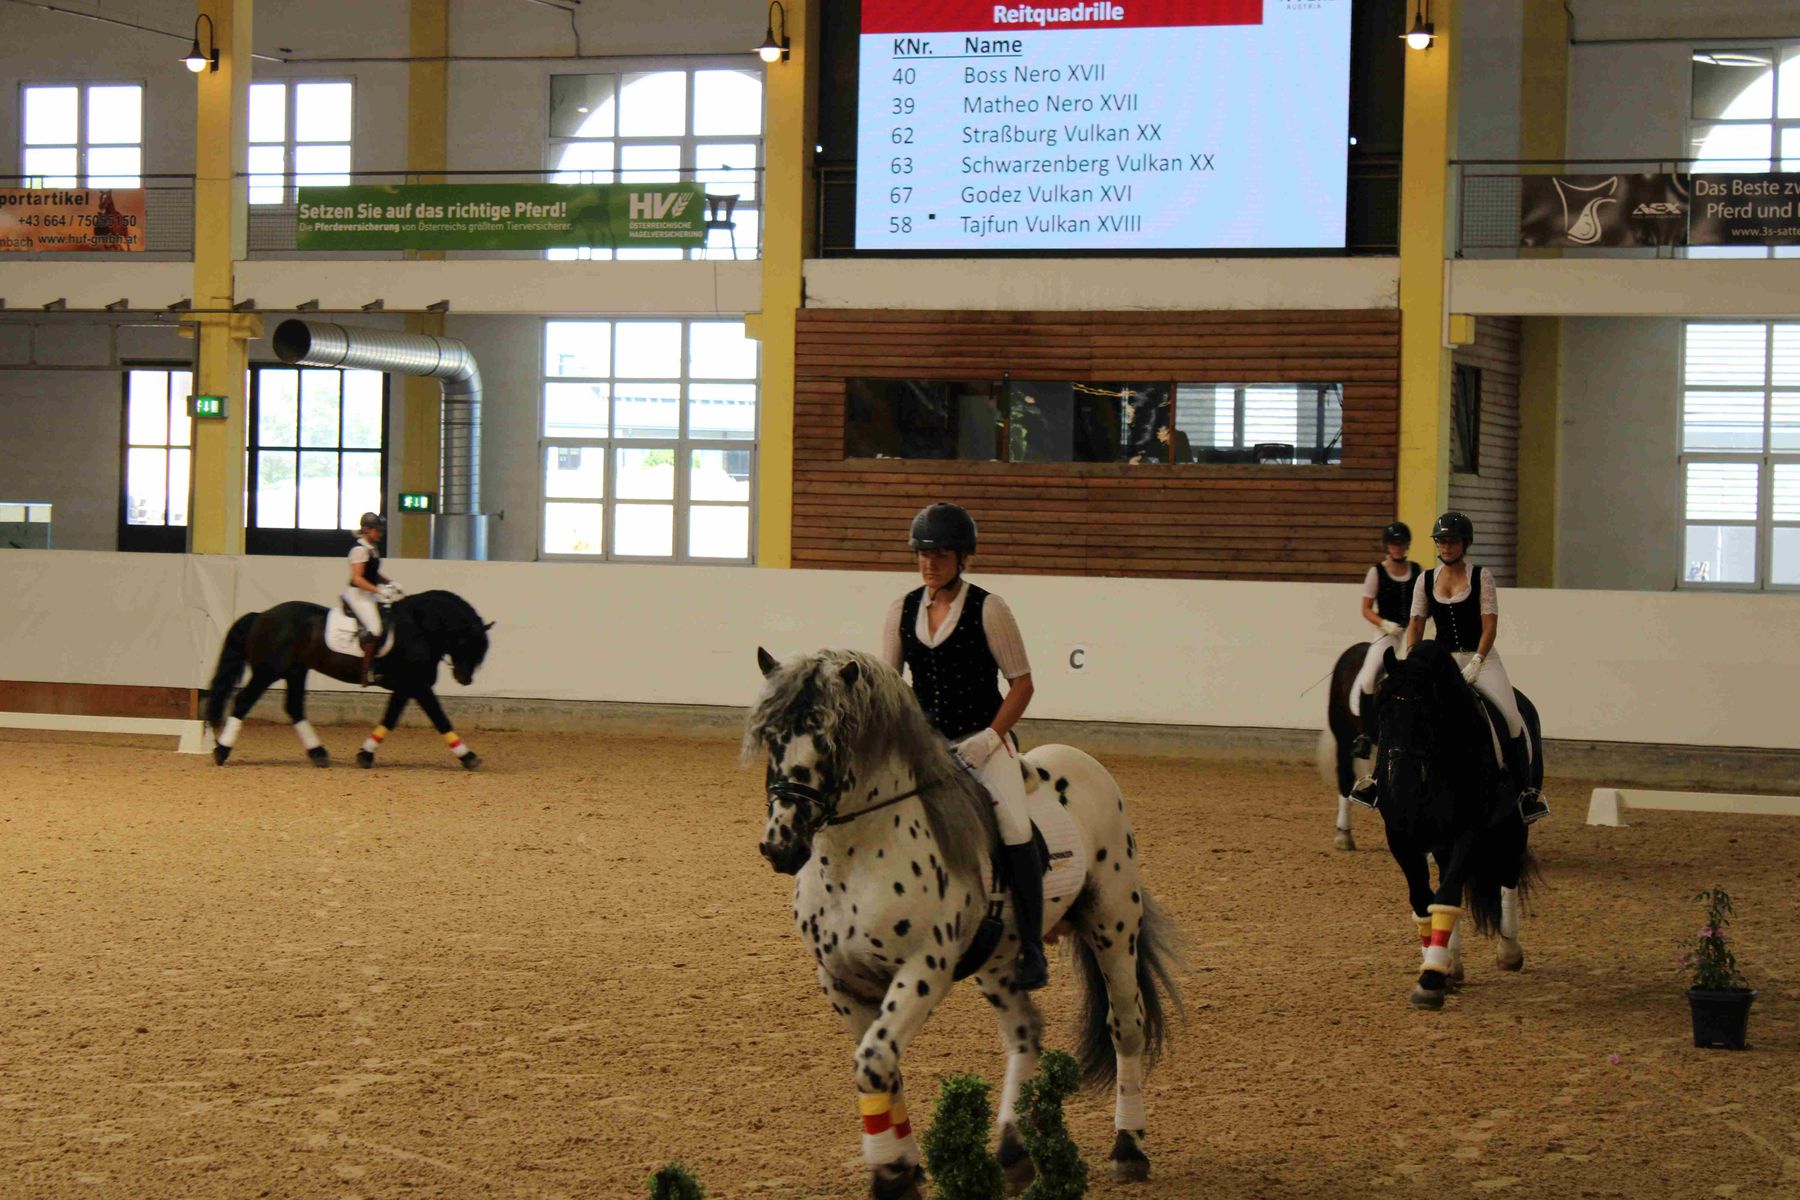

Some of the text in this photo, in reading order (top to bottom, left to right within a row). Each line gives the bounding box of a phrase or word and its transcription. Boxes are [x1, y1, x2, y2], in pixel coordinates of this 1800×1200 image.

[993, 2, 1125, 26] Reitquadrille
[894, 37, 1023, 55] KNr. Name
[892, 64, 1105, 84] 40 Boss Nero XVII
[892, 94, 1138, 114] 39 Matheo Nero XVII
[891, 124, 1162, 146] 62 Straßburg Vulkan XX
[890, 154, 1215, 176] 63 Schwarzenberg Vulkan XX
[890, 185, 1132, 204] 67 Godez Vulkan XVI
[1695, 180, 1727, 196] Das
[1732, 180, 1779, 195] Beste
[0, 192, 90, 208] portartikel
[629, 192, 678, 219] HV
[299, 202, 567, 221] Setzen Sie auf das richtige Pferd!
[1707, 203, 1752, 218] Pferd
[1757, 203, 1793, 218] und
[18, 215, 40, 226] +43
[44, 215, 66, 226] 664
[69, 215, 74, 226] /
[299, 223, 313, 232] Die
[315, 222, 400, 232] Pferdeversicherung
[418, 221, 467, 232] Österreichs
[468, 222, 504, 233] größtem
[506, 221, 573, 232] Tierversicherer.
[889, 215, 1141, 237] 58 Tajfun Vulkan XVIII
[1069, 648, 1085, 670] C
